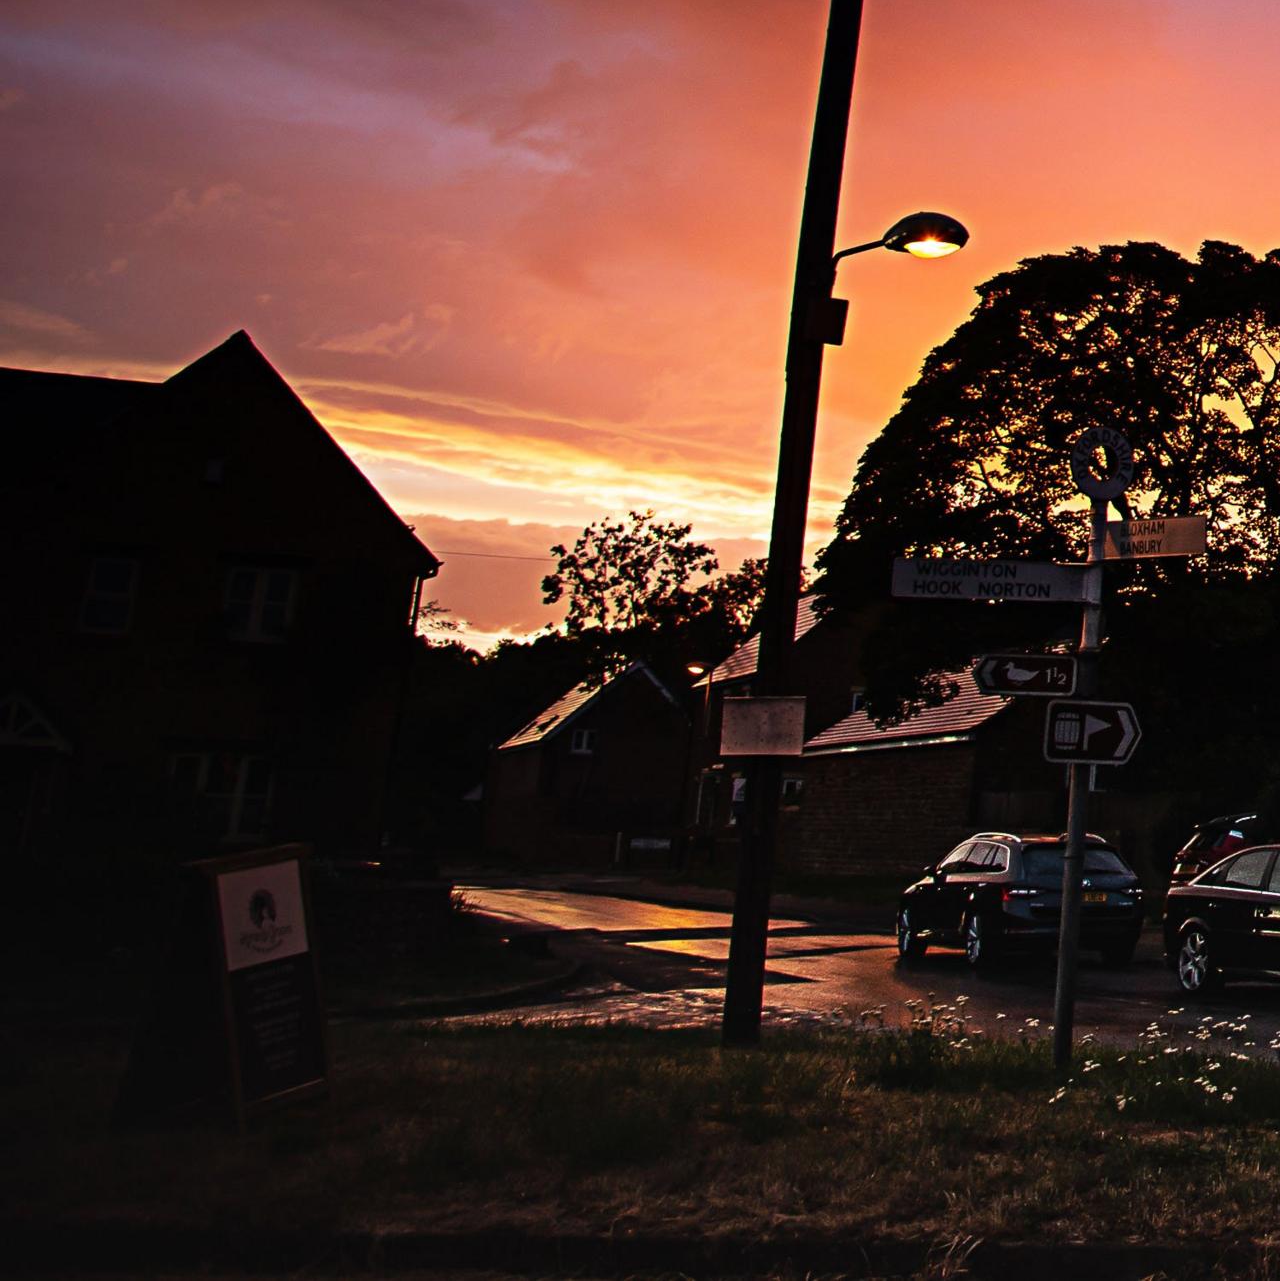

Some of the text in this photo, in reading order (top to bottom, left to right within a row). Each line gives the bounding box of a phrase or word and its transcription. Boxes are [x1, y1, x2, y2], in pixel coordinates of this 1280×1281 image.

[1075, 430, 1131, 485] OXFORDSHIRE
[1120, 521, 1165, 537] BLOXHAM
[1119, 539, 1162, 554] BANBURY
[916, 561, 1017, 578] WIGGINTON
[913, 580, 1050, 598] HOOK NORTON
